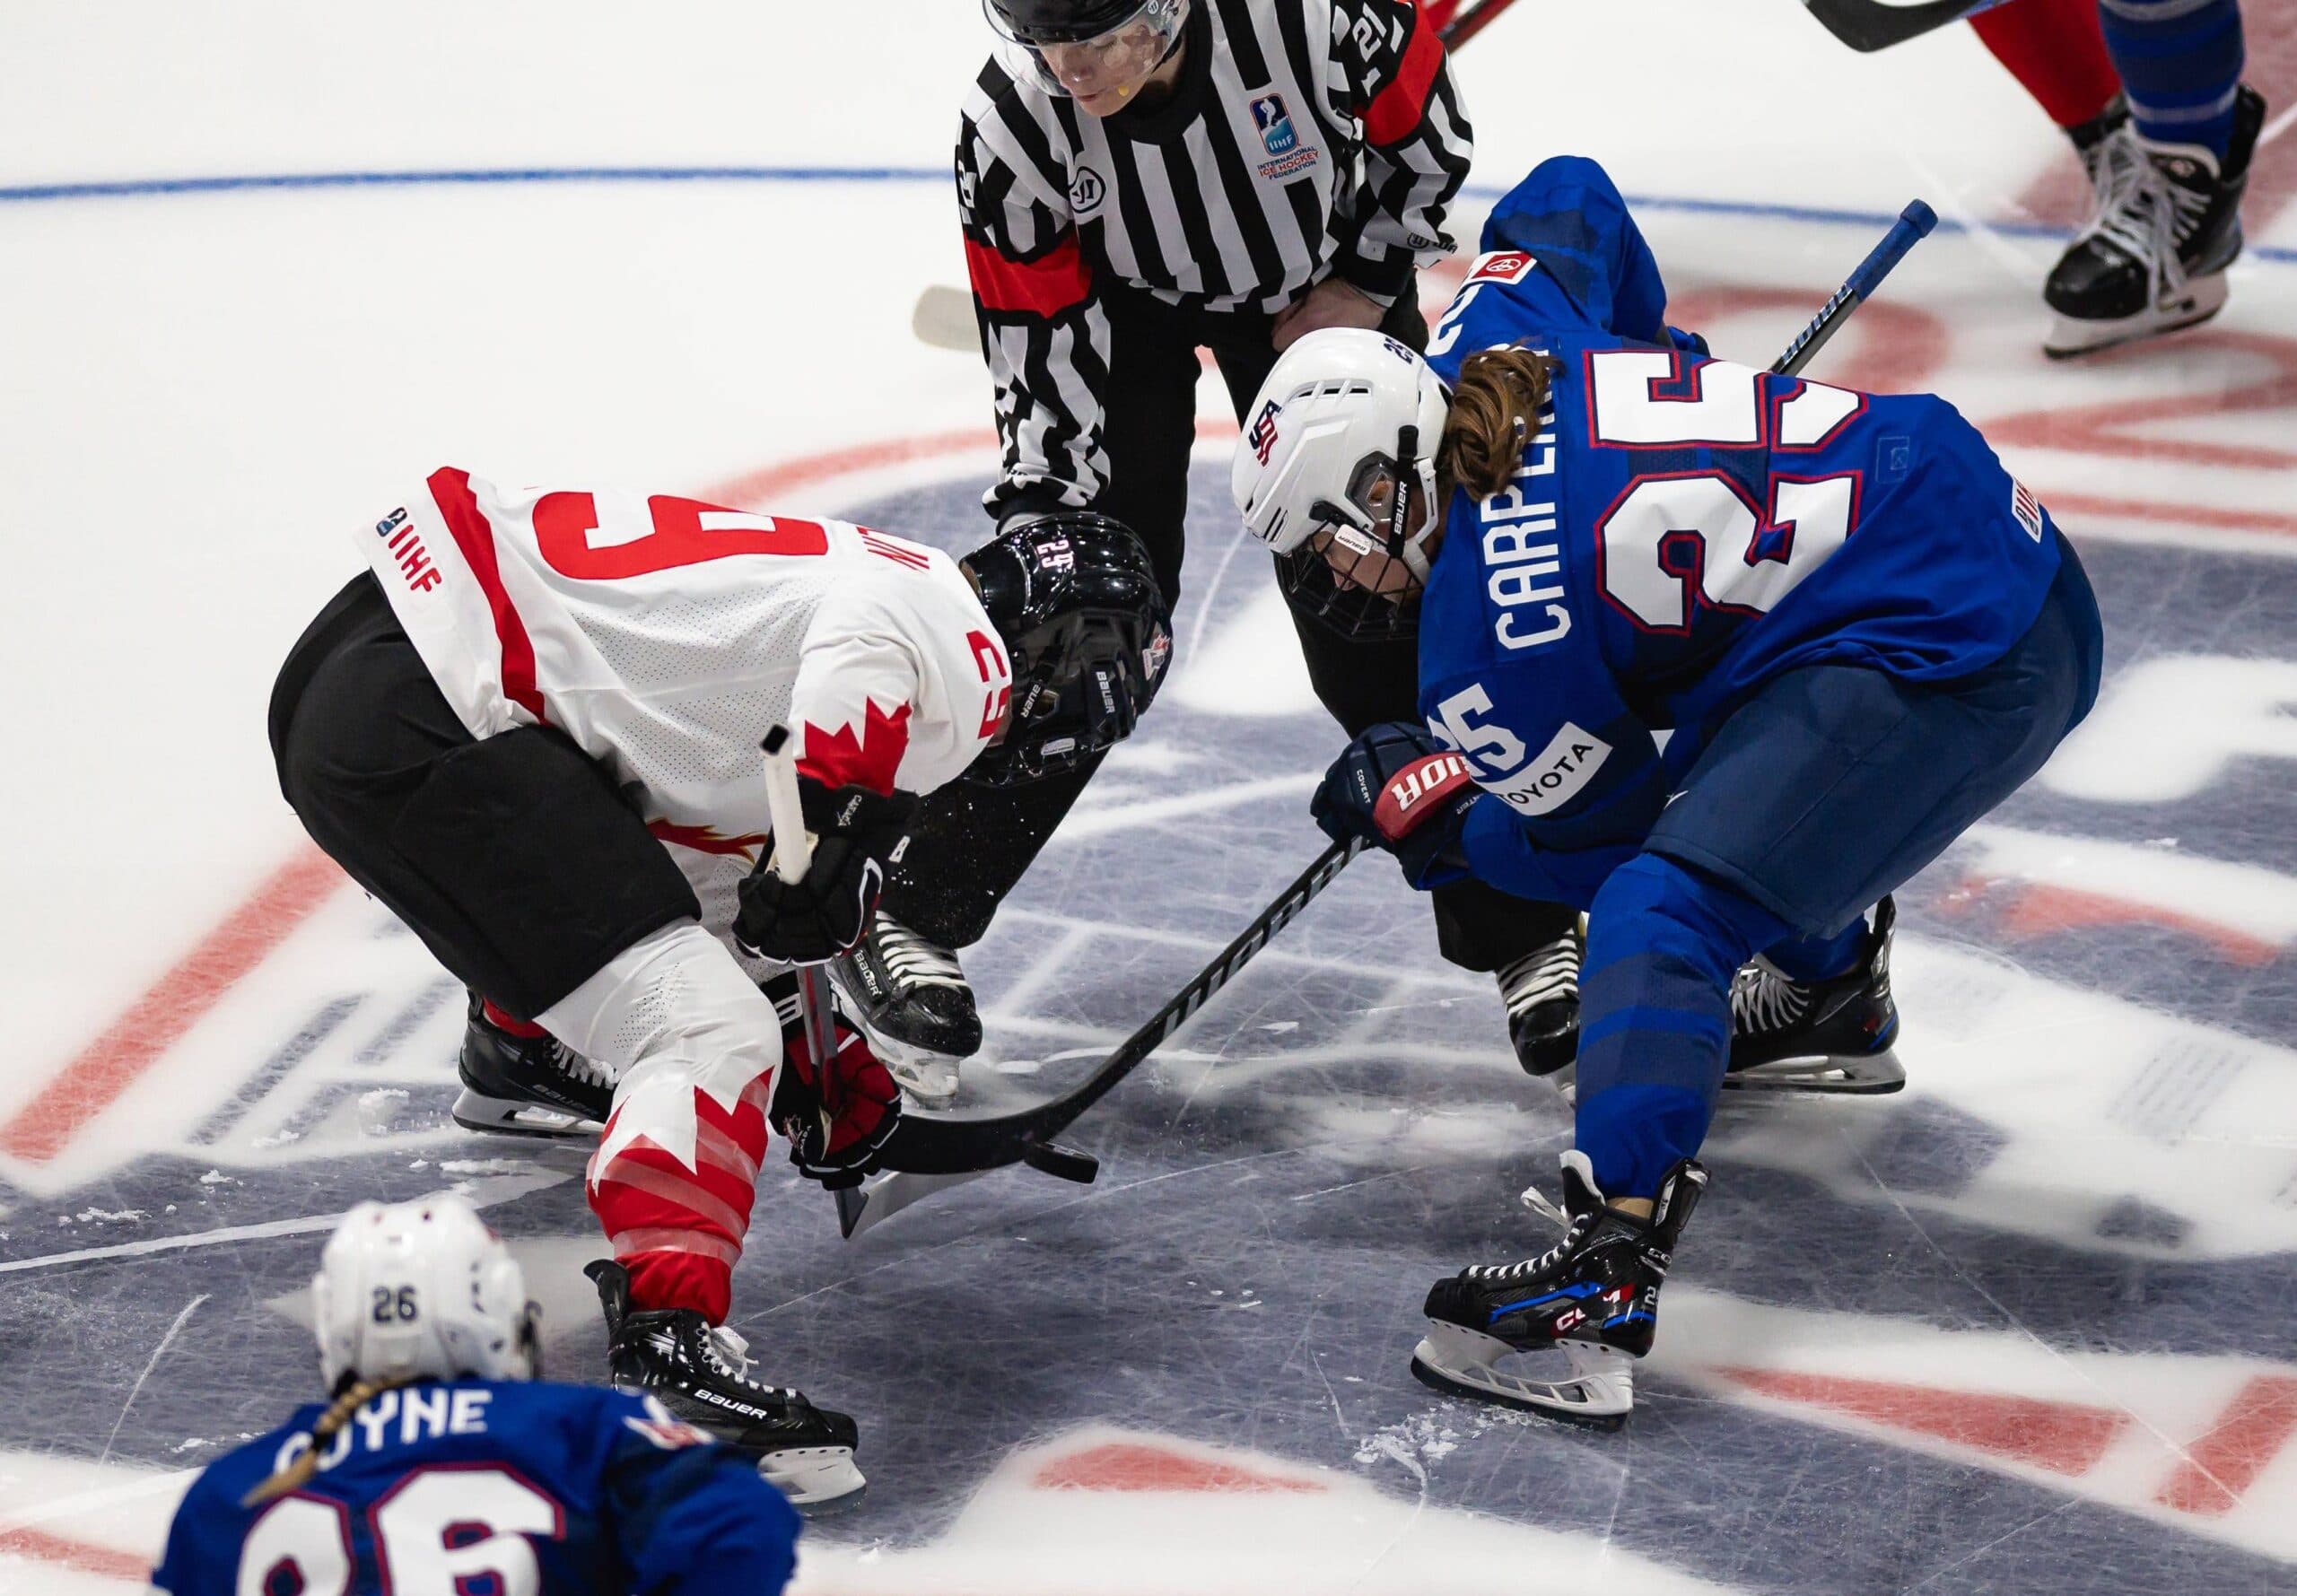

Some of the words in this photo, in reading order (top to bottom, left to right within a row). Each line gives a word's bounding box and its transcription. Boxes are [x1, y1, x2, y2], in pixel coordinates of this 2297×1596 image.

[1257, 145, 1317, 170] INTERNATIONAL
[1269, 135, 1292, 151] IIHF
[1259, 166, 1277, 178] ICE
[1279, 151, 1319, 171] HOCKEY
[1269, 161, 1317, 179] FEDERATION
[1393, 481, 1408, 535] BAUER
[1582, 350, 1869, 638] 25
[389, 524, 442, 592] IIHF
[1036, 539, 1074, 570] 29
[1020, 685, 1041, 718] AUER
[1095, 671, 1116, 714] BAUER
[1357, 768, 1371, 804] COVERT
[371, 1285, 417, 1323] 26
[694, 1389, 768, 1419] BAUER
